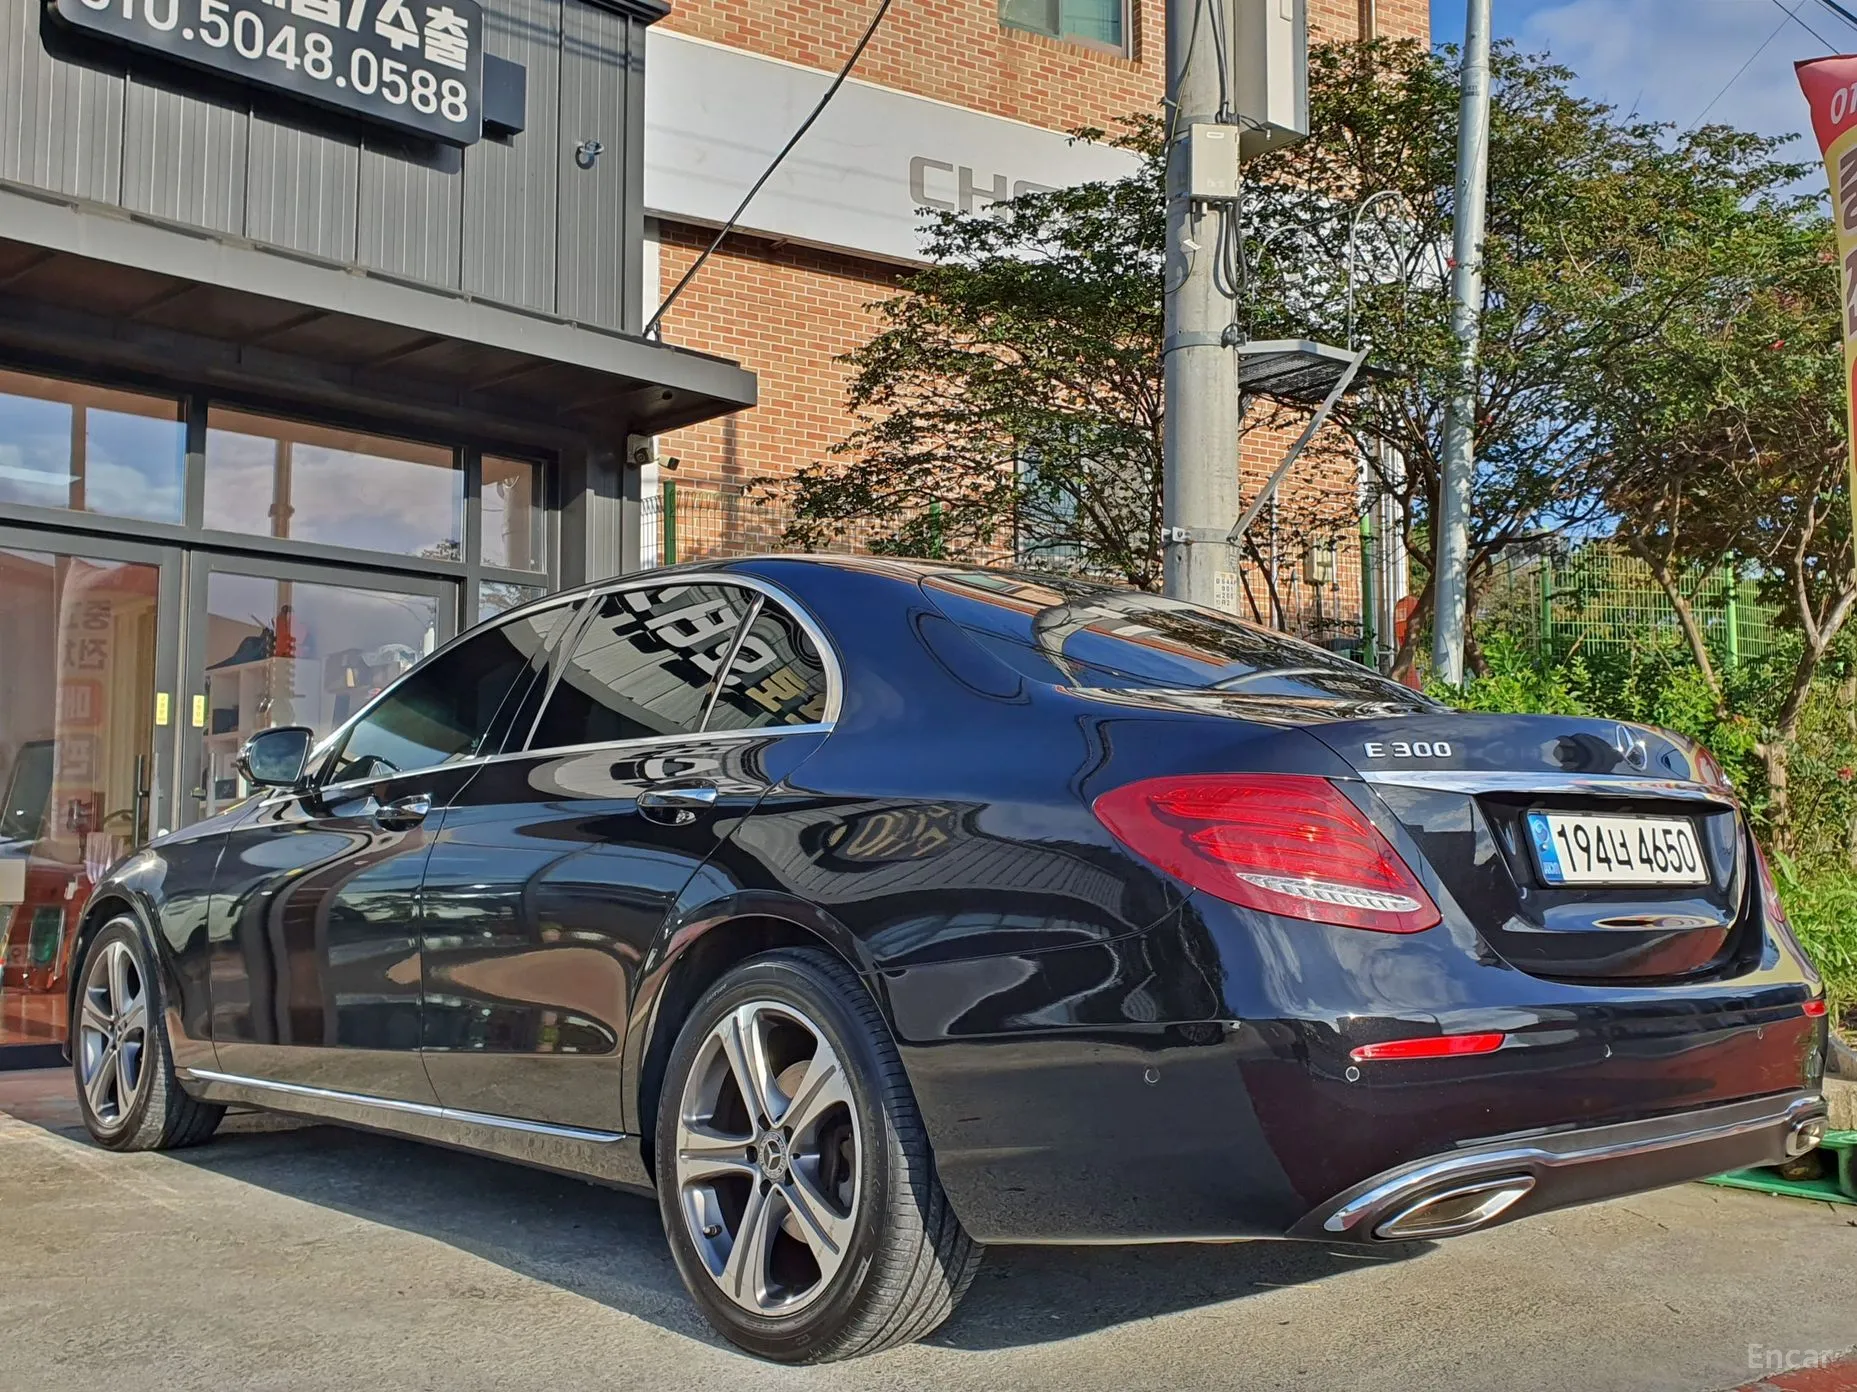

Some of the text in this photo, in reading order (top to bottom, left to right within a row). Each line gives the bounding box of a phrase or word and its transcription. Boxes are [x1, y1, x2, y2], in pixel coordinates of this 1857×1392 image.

[80, 0, 468, 123] 0.5048.0588
[261, 0, 469, 71] /수출
[909, 156, 1060, 222] CH
[1364, 741, 1452, 758] E 300
[1557, 824, 1697, 873] 194너 4650
